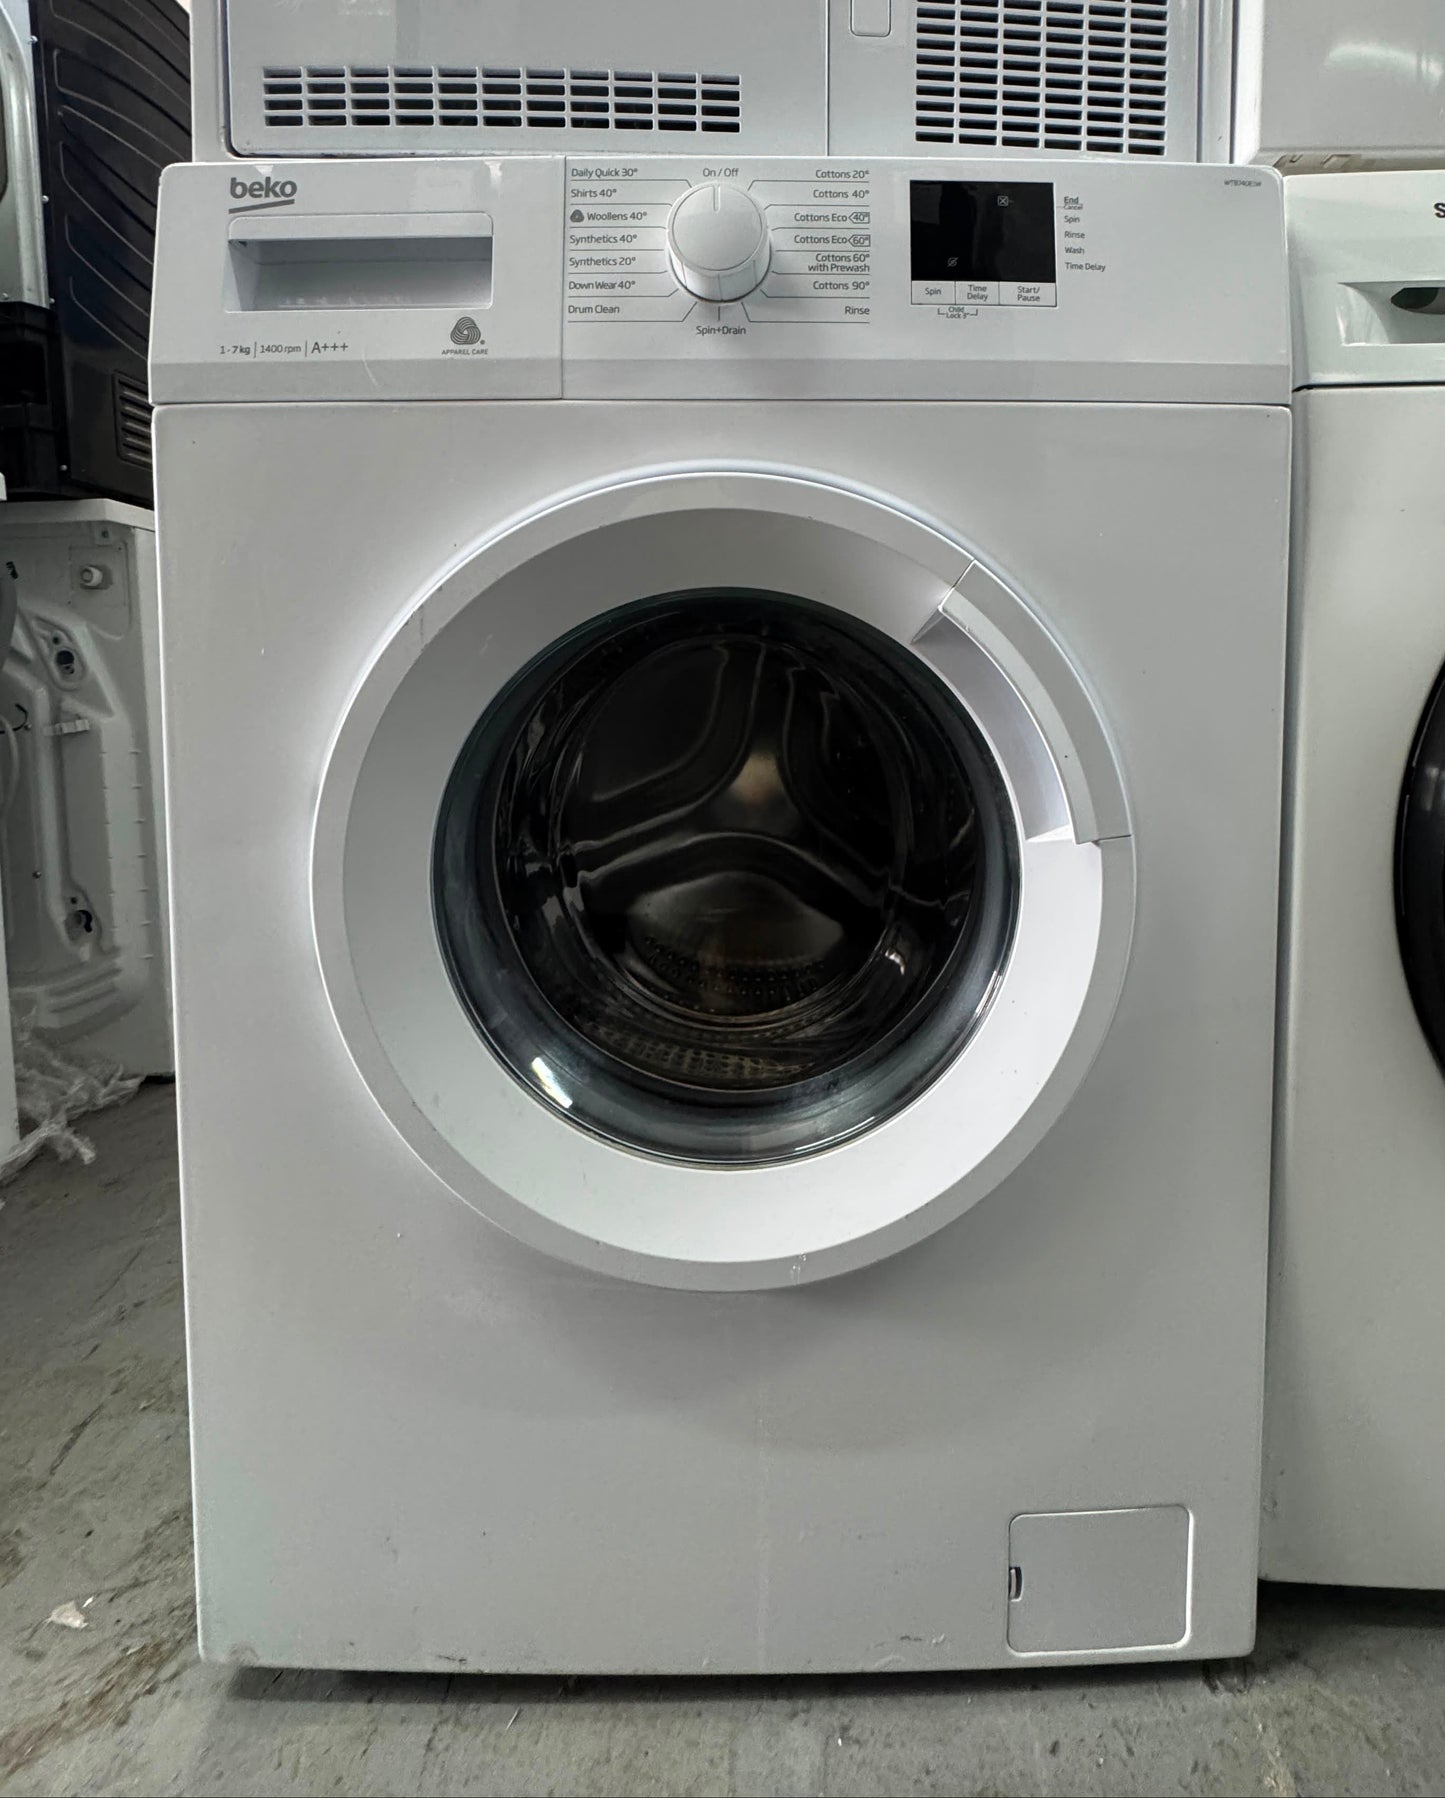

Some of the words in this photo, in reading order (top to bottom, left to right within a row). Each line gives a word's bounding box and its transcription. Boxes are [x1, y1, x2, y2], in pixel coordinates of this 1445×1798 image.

[571, 168, 594, 179] Daily
[595, 168, 620, 178] Quick
[702, 167, 717, 177] On
[724, 167, 739, 177] Off
[815, 169, 851, 179] Cottons
[229, 176, 297, 199] beko
[570, 188, 598, 198] Shirts
[813, 189, 849, 198] Cottons
[1063, 196, 1080, 205] End
[587, 211, 628, 221] Woollens
[794, 212, 830, 222] Cottons
[831, 213, 848, 222] Eco
[1064, 215, 1080, 224] Spin
[794, 234, 830, 244] Cottons
[831, 235, 848, 244] Eco
[1064, 230, 1086, 239] Rinse
[569, 235, 618, 246] Synthetics
[1064, 246, 1086, 255] Wash
[569, 257, 617, 268] Synthetics
[815, 253, 851, 262] Cottons
[807, 263, 829, 272] with
[830, 263, 870, 273] Prewash
[1064, 262, 1084, 270] Time
[1084, 263, 1106, 273] Delay
[568, 281, 594, 290] Down
[595, 280, 617, 290] Wear
[813, 280, 849, 290] Cottons
[968, 284, 988, 293] Time
[1017, 285, 1041, 295] Start/
[925, 287, 942, 297] Spin
[967, 292, 989, 302] Delay
[1017, 294, 1041, 303] Pause
[568, 305, 594, 314] Drum
[594, 304, 621, 314] Clean
[844, 305, 870, 315] Rinse
[948, 305, 965, 313] Child
[945, 312, 962, 320] Lock
[695, 325, 747, 337] Spin+Drain
[259, 343, 284, 354] 1400
[284, 345, 302, 355] rpm
[310, 341, 350, 354] A+++
[441, 348, 470, 356] APPAREL
